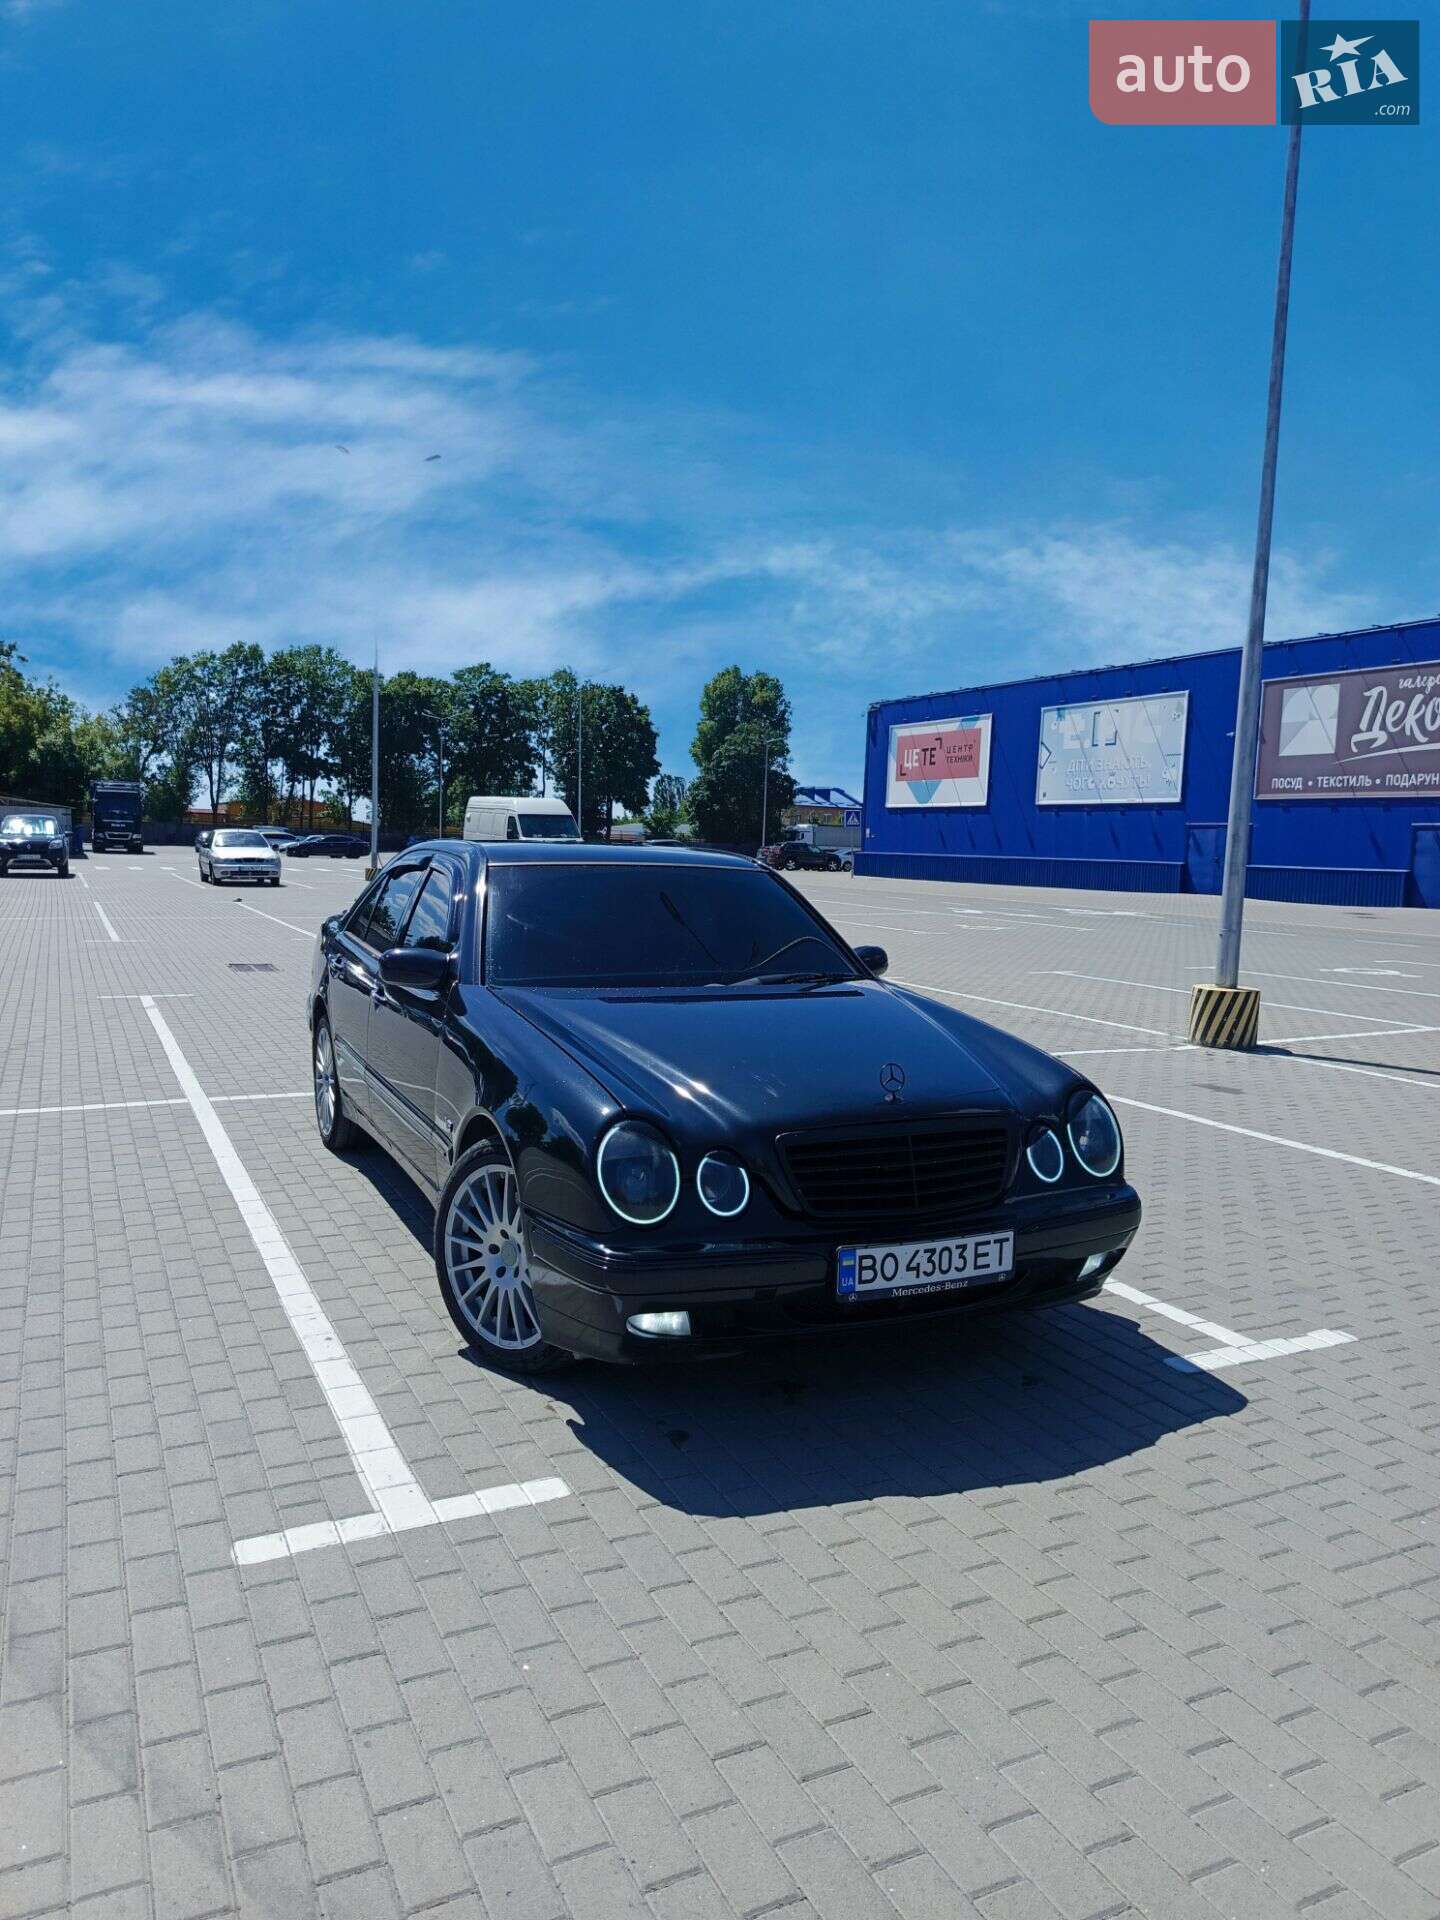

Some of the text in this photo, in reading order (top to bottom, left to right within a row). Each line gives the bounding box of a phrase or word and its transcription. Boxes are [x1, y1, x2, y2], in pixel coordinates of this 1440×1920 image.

[904, 747, 937, 769] ЦЕТЕ
[1271, 777, 1303, 790] ПОСУД
[1317, 775, 1372, 788] ТЕКСТИЛЬ
[858, 1237, 1010, 1285] BO 4303 ET
[841, 1277, 854, 1287] UA
[891, 1280, 968, 1297] Mercedes-Benz
